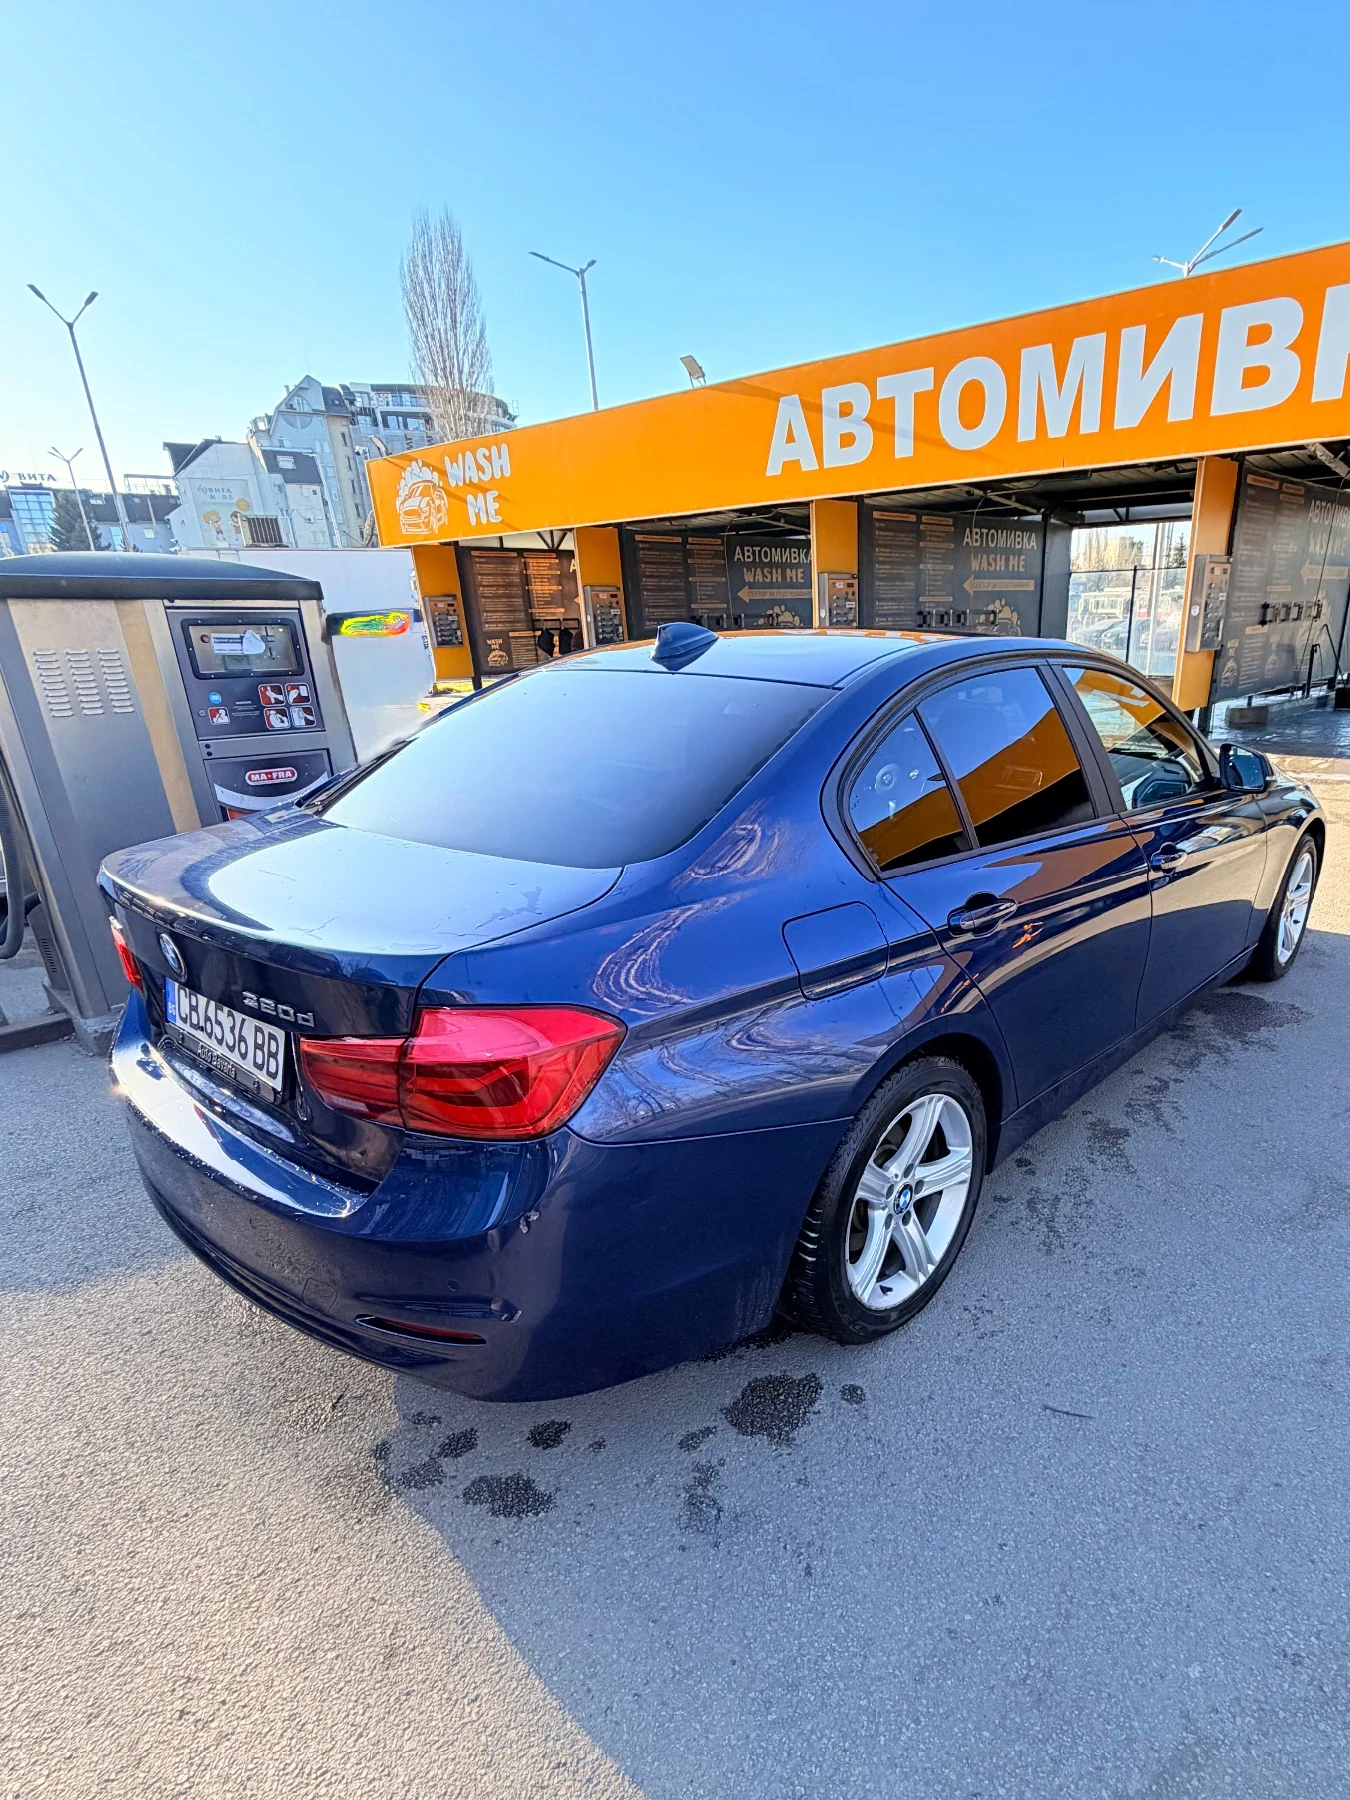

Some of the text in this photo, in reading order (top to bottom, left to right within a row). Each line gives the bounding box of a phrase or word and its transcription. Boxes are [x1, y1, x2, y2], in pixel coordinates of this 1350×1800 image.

[18, 473, 57, 482] ВИТА
[444, 444, 511, 487] WASH
[466, 490, 502, 526] ME
[1307, 499, 1350, 528] АВТОМИВ
[963, 527, 1037, 550] АВТОМИВКА
[743, 567, 805, 583] WASH ME
[971, 553, 1026, 571] WASH ME
[177, 984, 280, 1081] CB 6536 BB
[211, 1052, 236, 1078] Bavaria
